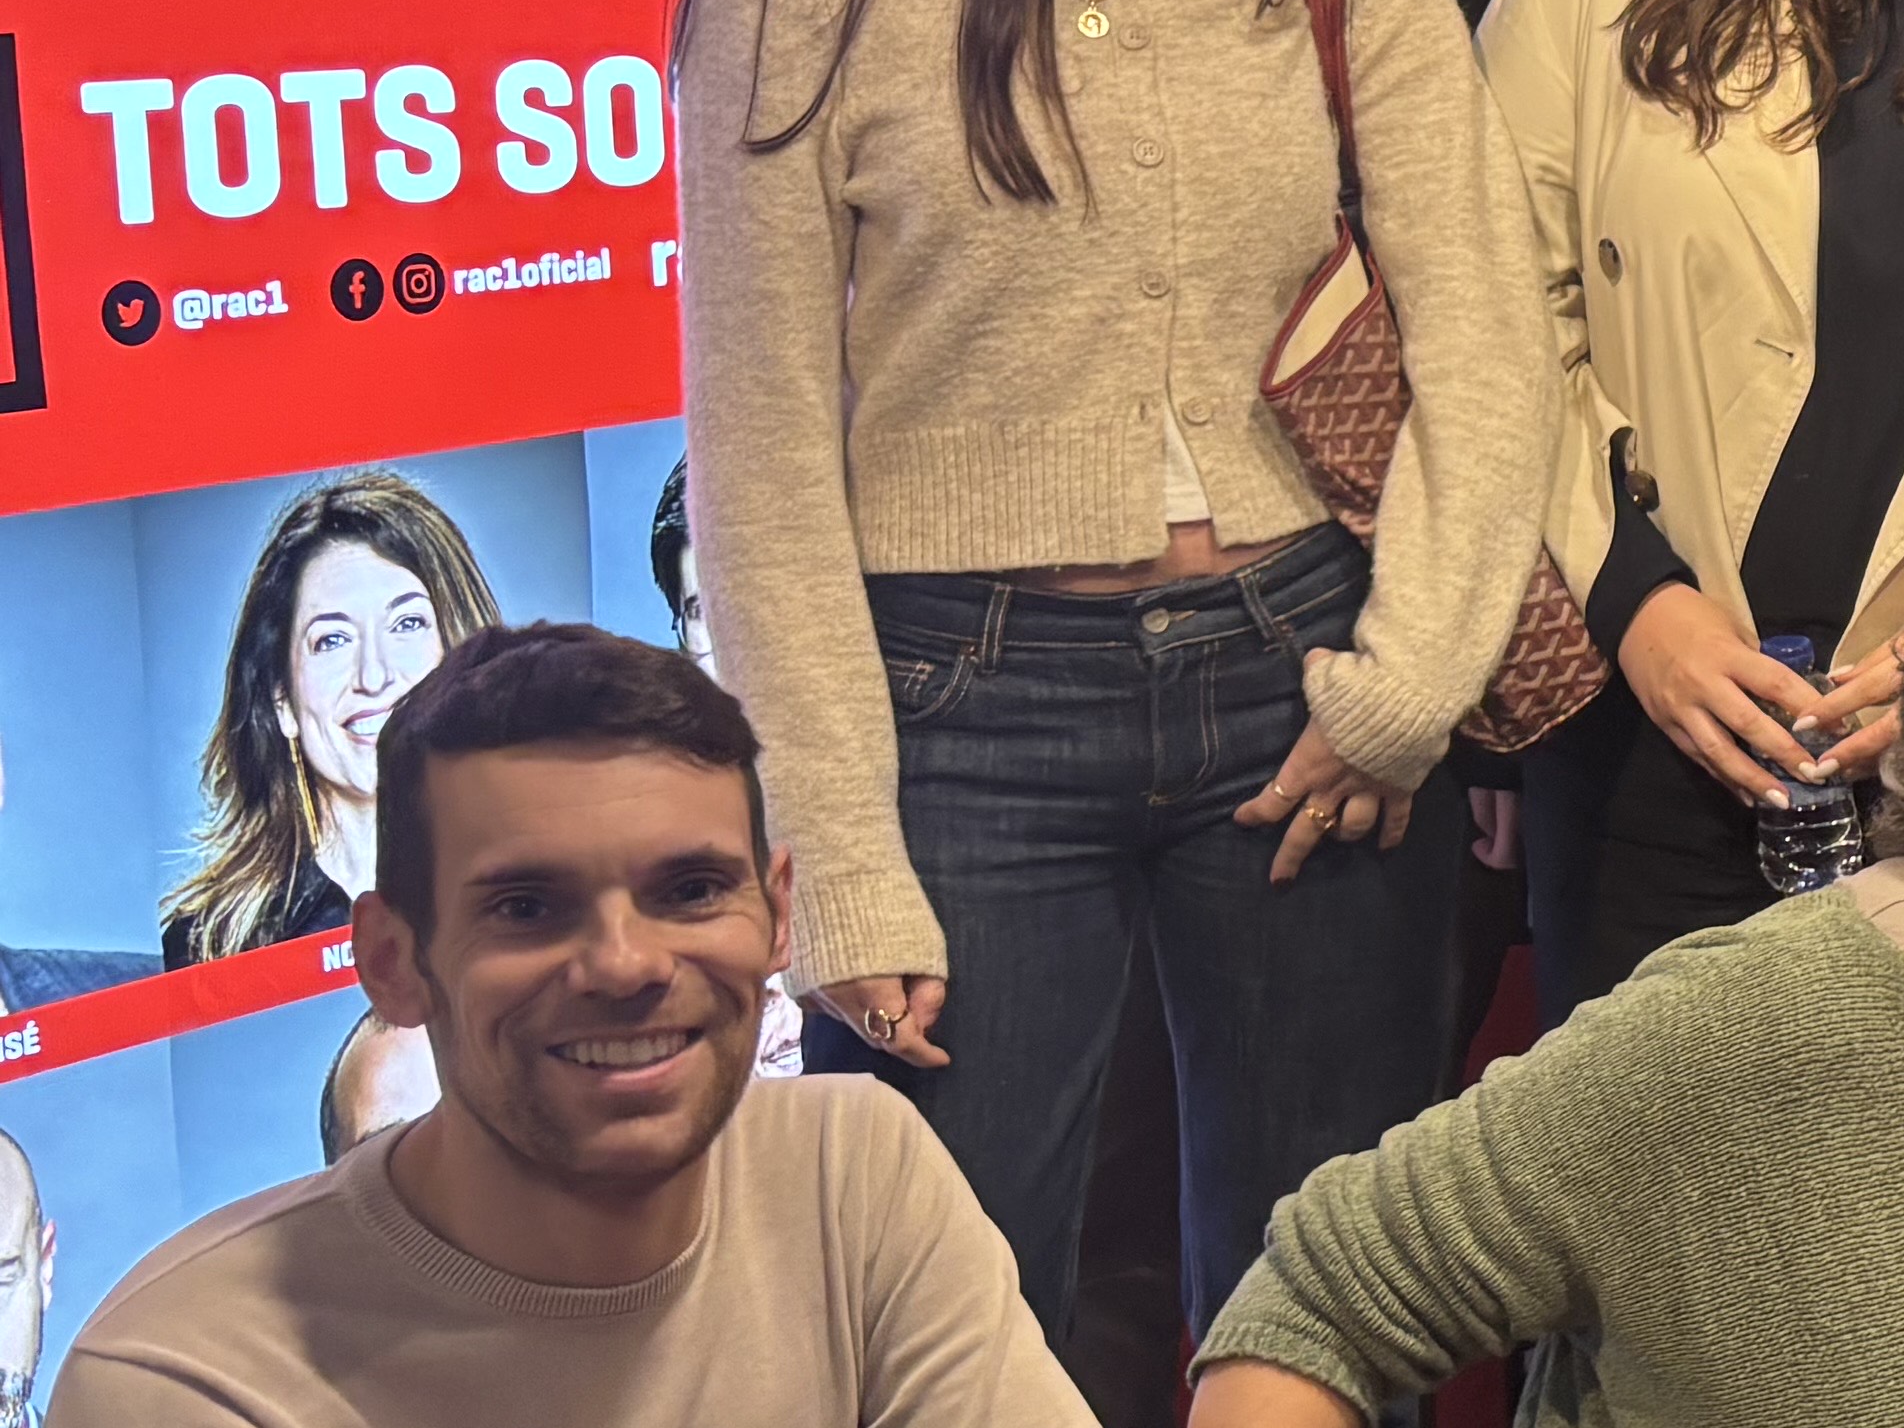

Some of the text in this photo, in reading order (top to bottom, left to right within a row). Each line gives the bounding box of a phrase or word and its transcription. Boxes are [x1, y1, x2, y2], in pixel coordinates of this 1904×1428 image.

[80, 63, 461, 225] TOTS
[454, 248, 611, 294] rac1oficial
[173, 281, 288, 329] @rac1
